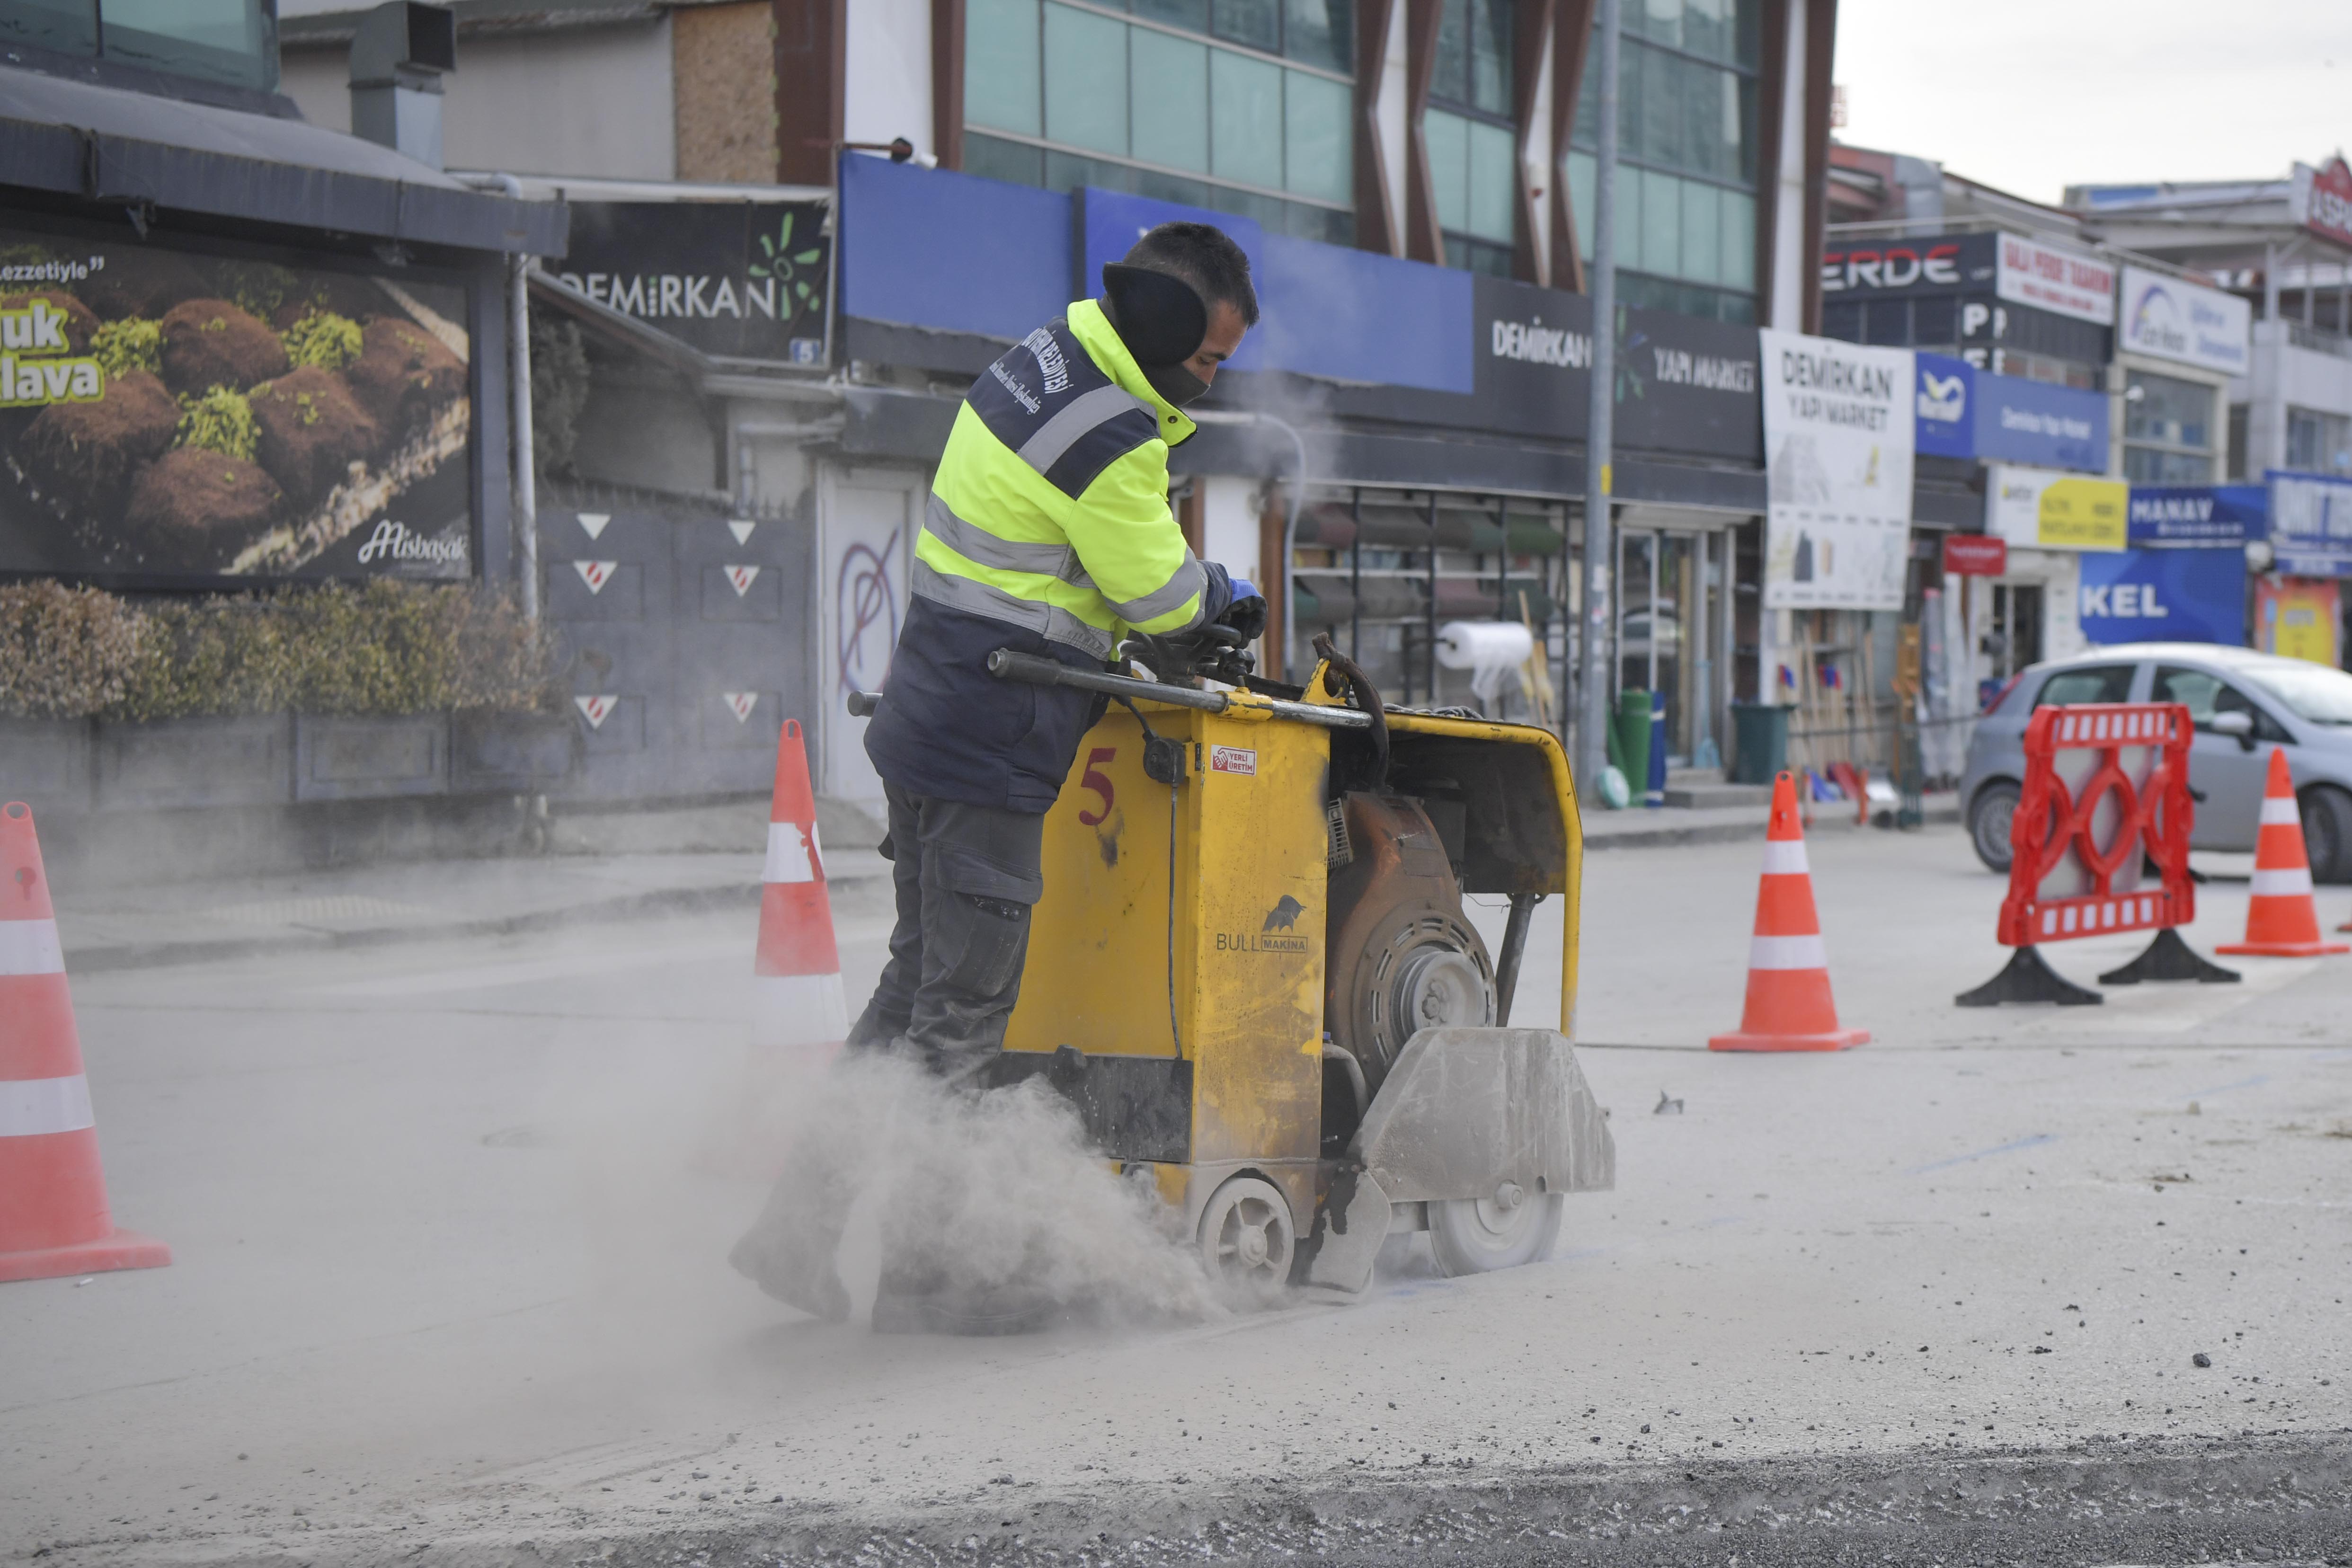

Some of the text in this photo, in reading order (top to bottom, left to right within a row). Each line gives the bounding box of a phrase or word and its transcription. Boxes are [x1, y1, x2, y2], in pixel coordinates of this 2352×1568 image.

[2131, 497, 2214, 521] MANAV
[2083, 584, 2169, 618] KEL
[1229, 762, 1252, 772] ÜRETİM
[1230, 753, 1247, 762] YERLİ
[1079, 747, 1117, 825] 5
[1216, 933, 1305, 952] BULL MAKİNA
